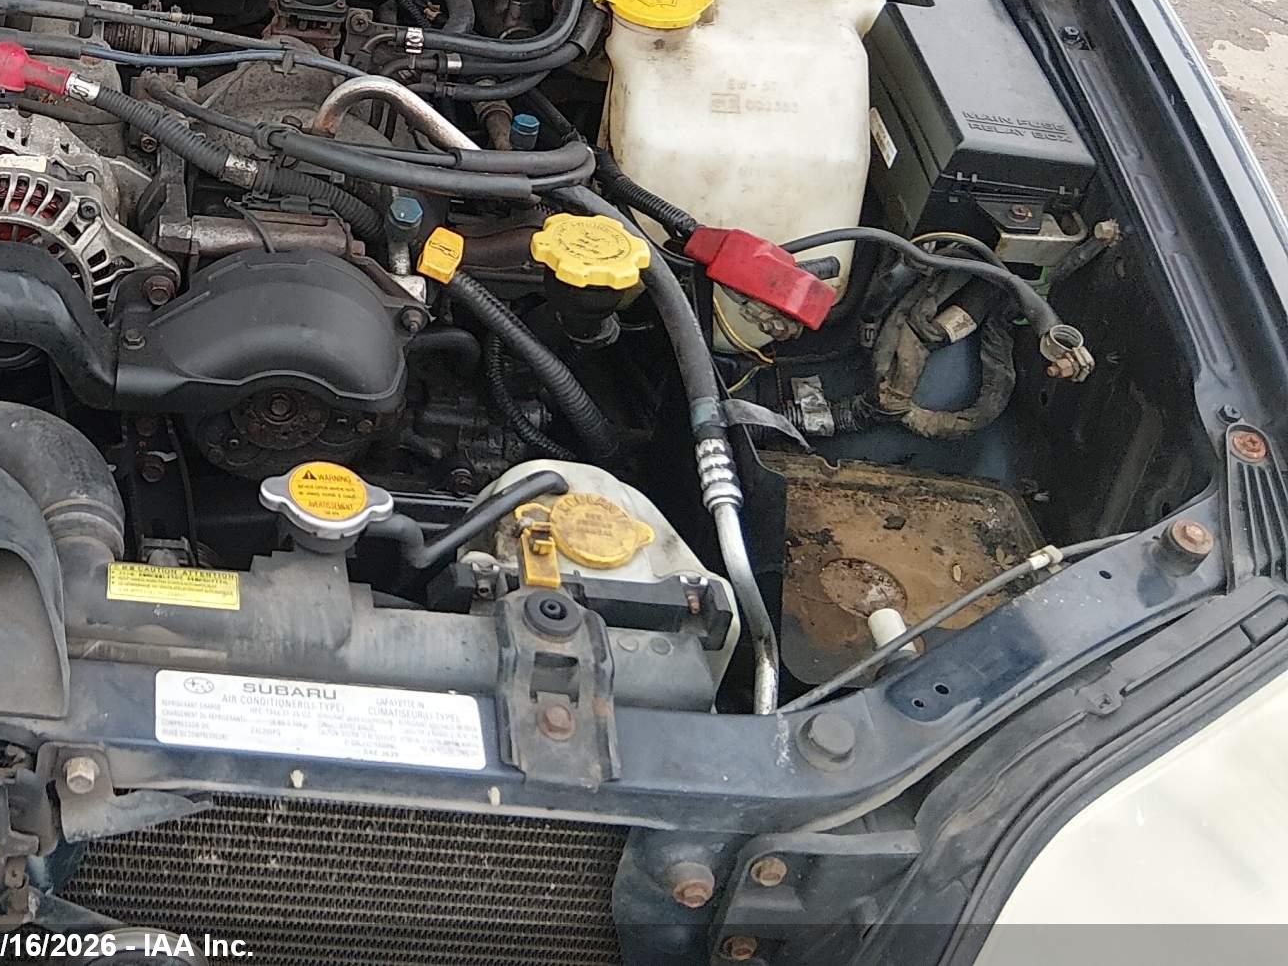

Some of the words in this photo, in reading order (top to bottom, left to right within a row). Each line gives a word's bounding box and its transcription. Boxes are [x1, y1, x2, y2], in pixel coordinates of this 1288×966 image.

[962, 111, 1013, 124] MAIN
[1016, 118, 1066, 132] FUSE
[968, 123, 1024, 137] RELAY
[1031, 131, 1073, 143] BOX
[317, 473, 352, 484] WARNING
[138, 566, 177, 575] CAUTION
[182, 569, 234, 580] ATTENTION
[222, 694, 238, 704] AIR
[242, 682, 337, 700] SUBARU
